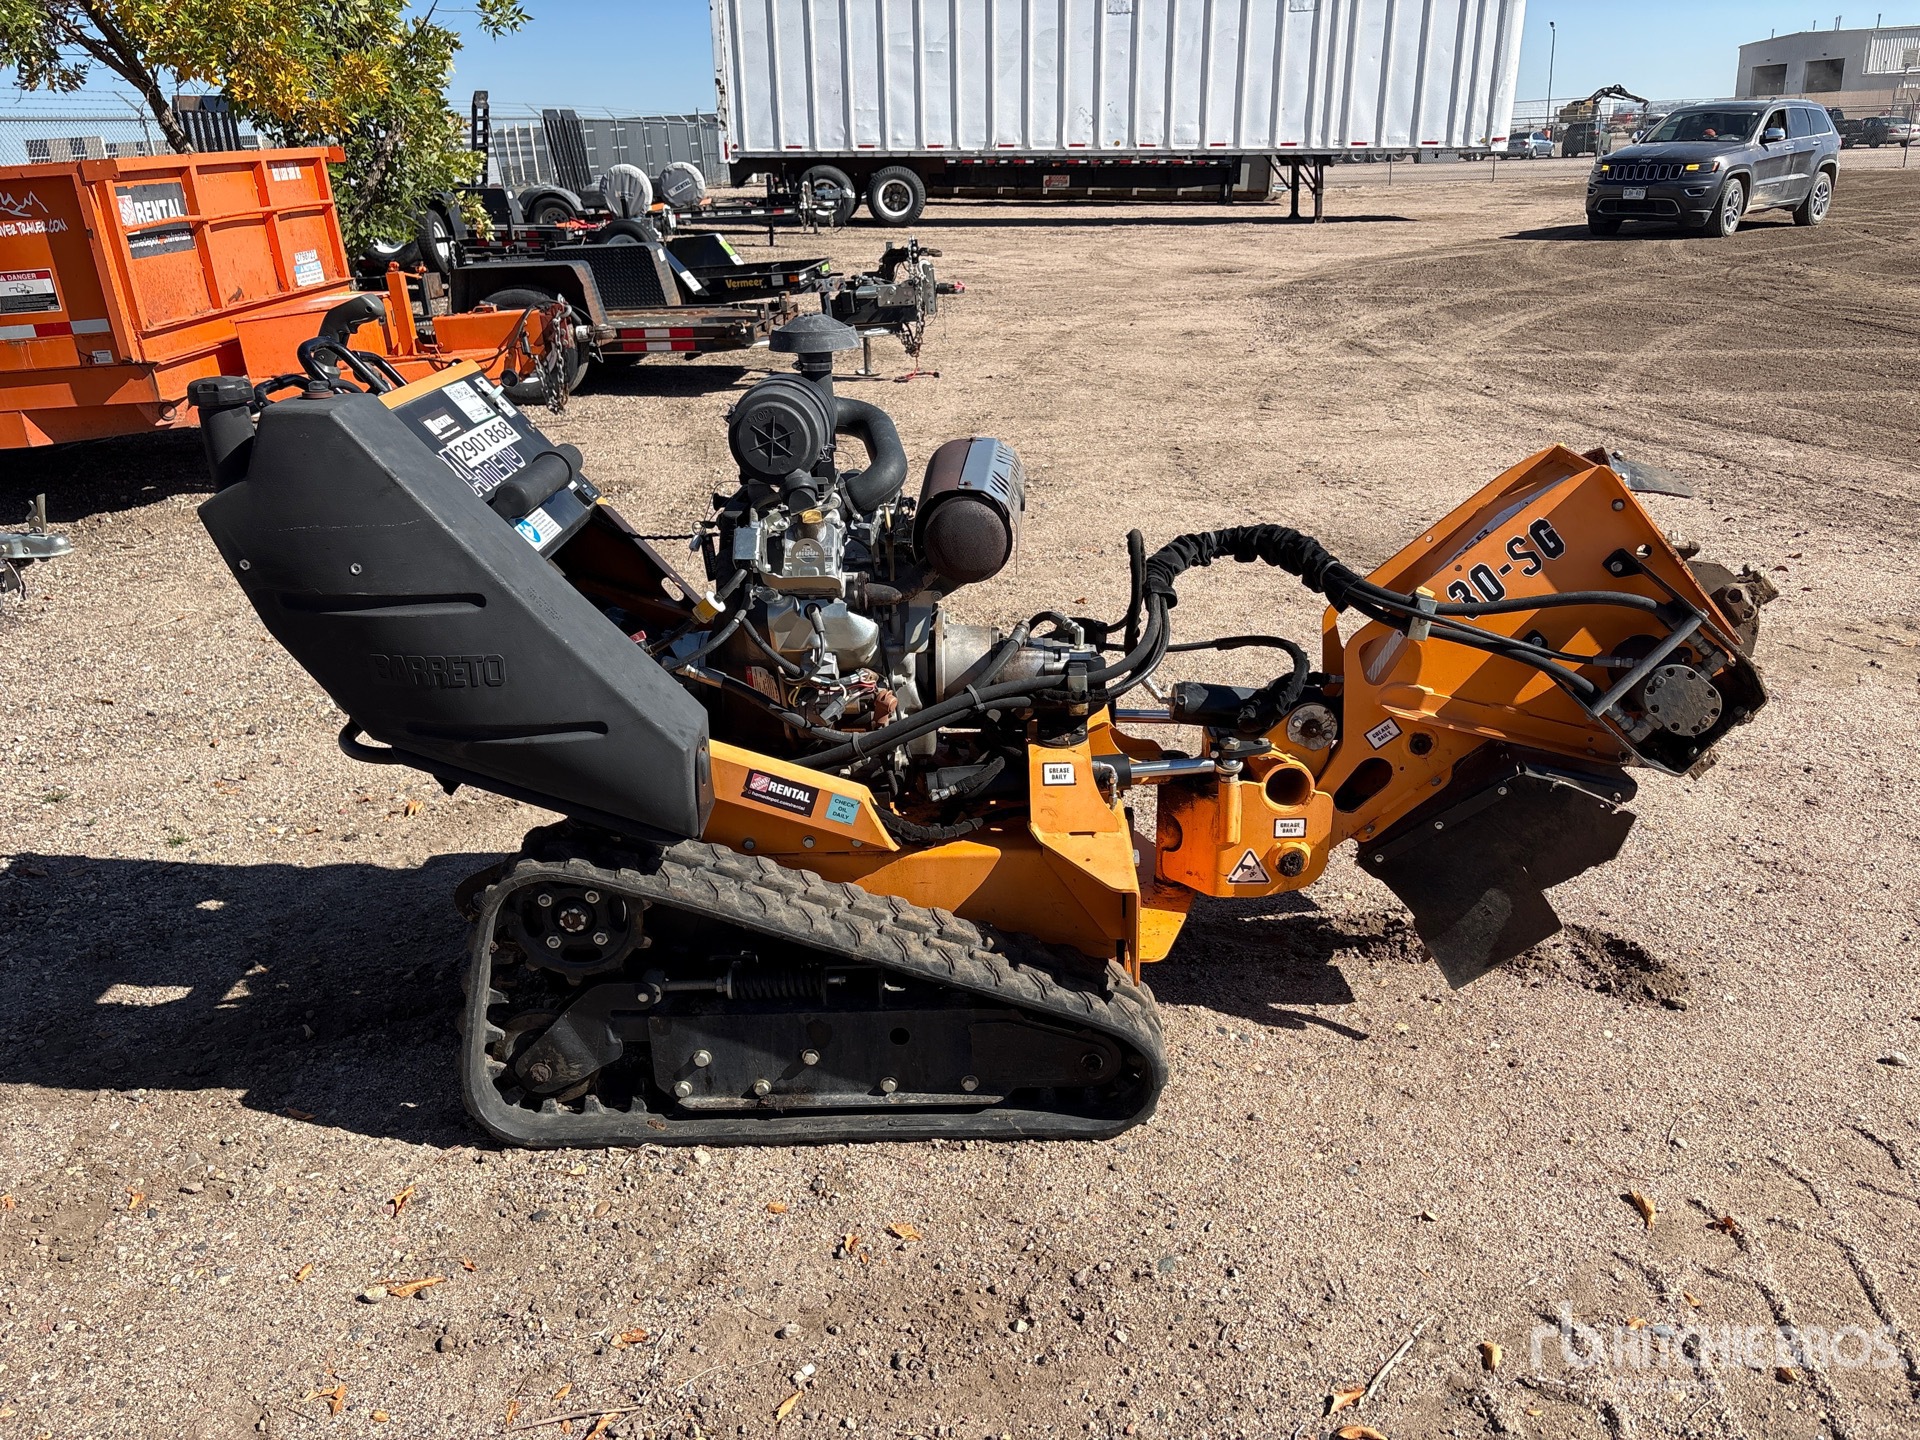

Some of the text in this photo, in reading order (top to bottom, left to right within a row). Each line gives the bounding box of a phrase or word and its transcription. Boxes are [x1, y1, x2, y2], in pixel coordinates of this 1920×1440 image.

[134, 198, 185, 224] RENTAL
[6, 272, 37, 281] DANGER
[725, 278, 763, 289] Vermeer
[453, 420, 514, 462] 2901868
[1446, 517, 1566, 621] 30-SG
[370, 653, 507, 689] BARRETO
[768, 781, 811, 804] RENTAL
[834, 798, 855, 809] CHECK
[837, 806, 848, 814] OIL
[832, 810, 850, 820] DAILY
